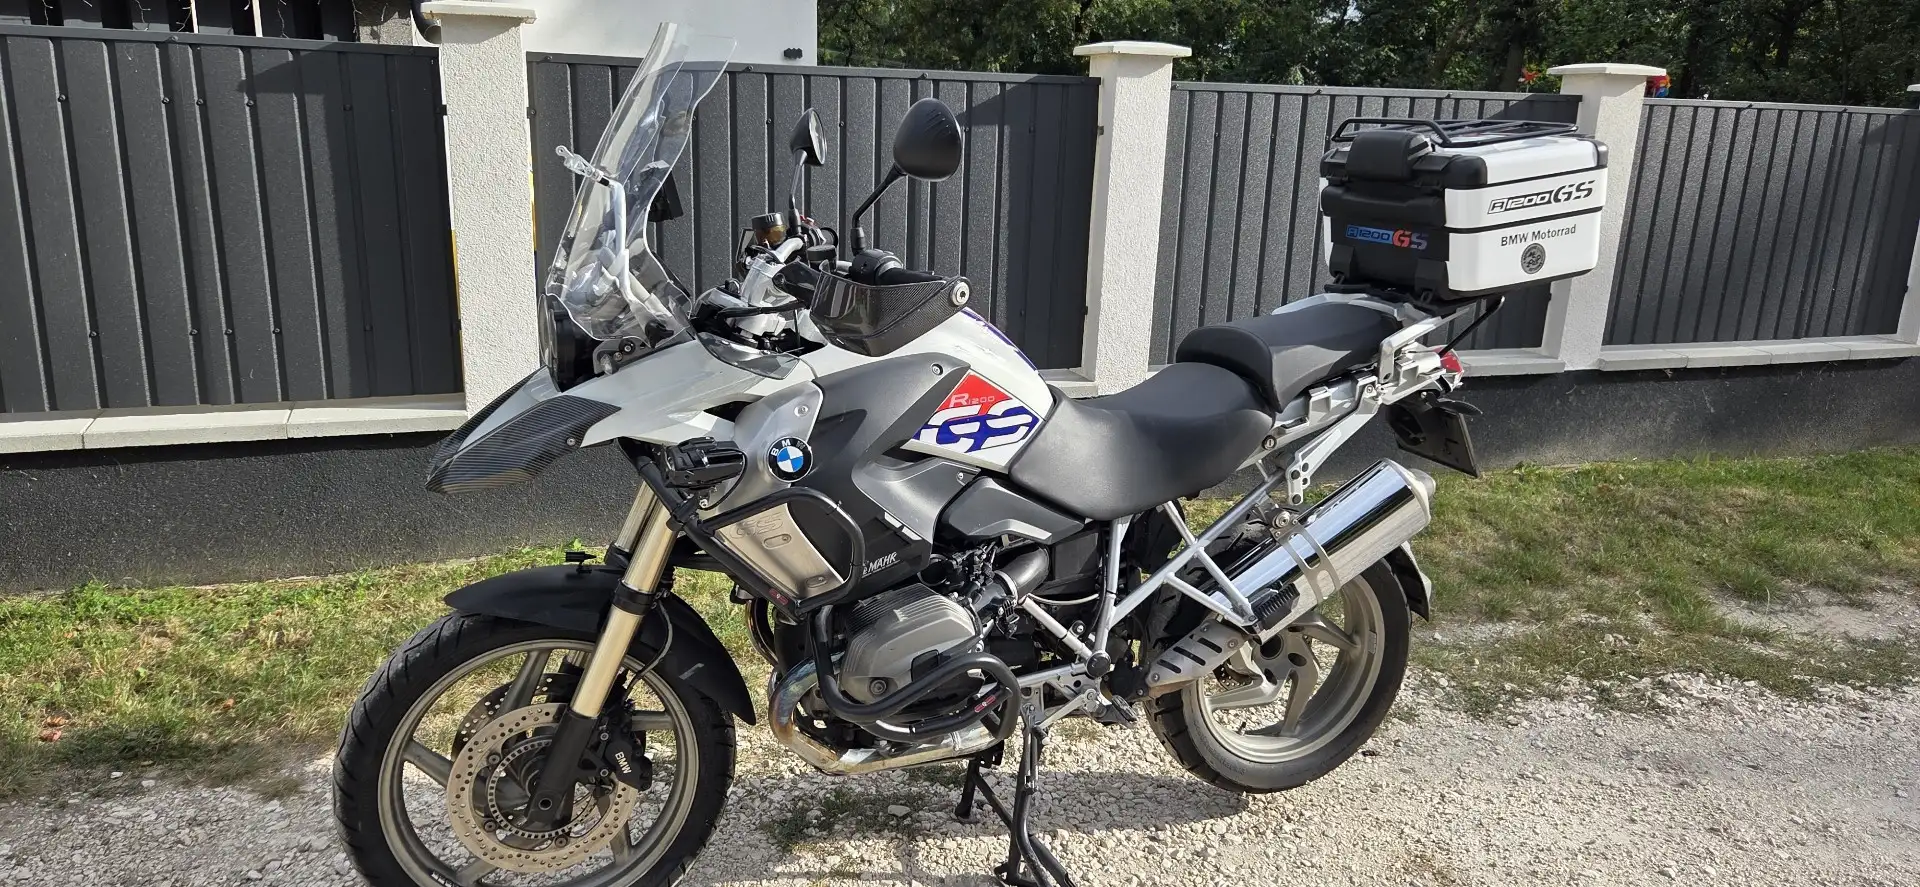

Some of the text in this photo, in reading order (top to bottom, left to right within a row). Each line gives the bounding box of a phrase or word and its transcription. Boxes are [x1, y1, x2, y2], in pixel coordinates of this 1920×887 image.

[1501, 224, 1577, 247] BMW Motorrad
[949, 393, 996, 408] R1200
[919, 400, 1034, 454] GS
[770, 438, 806, 457] BMW
[615, 751, 632, 774] BMW
